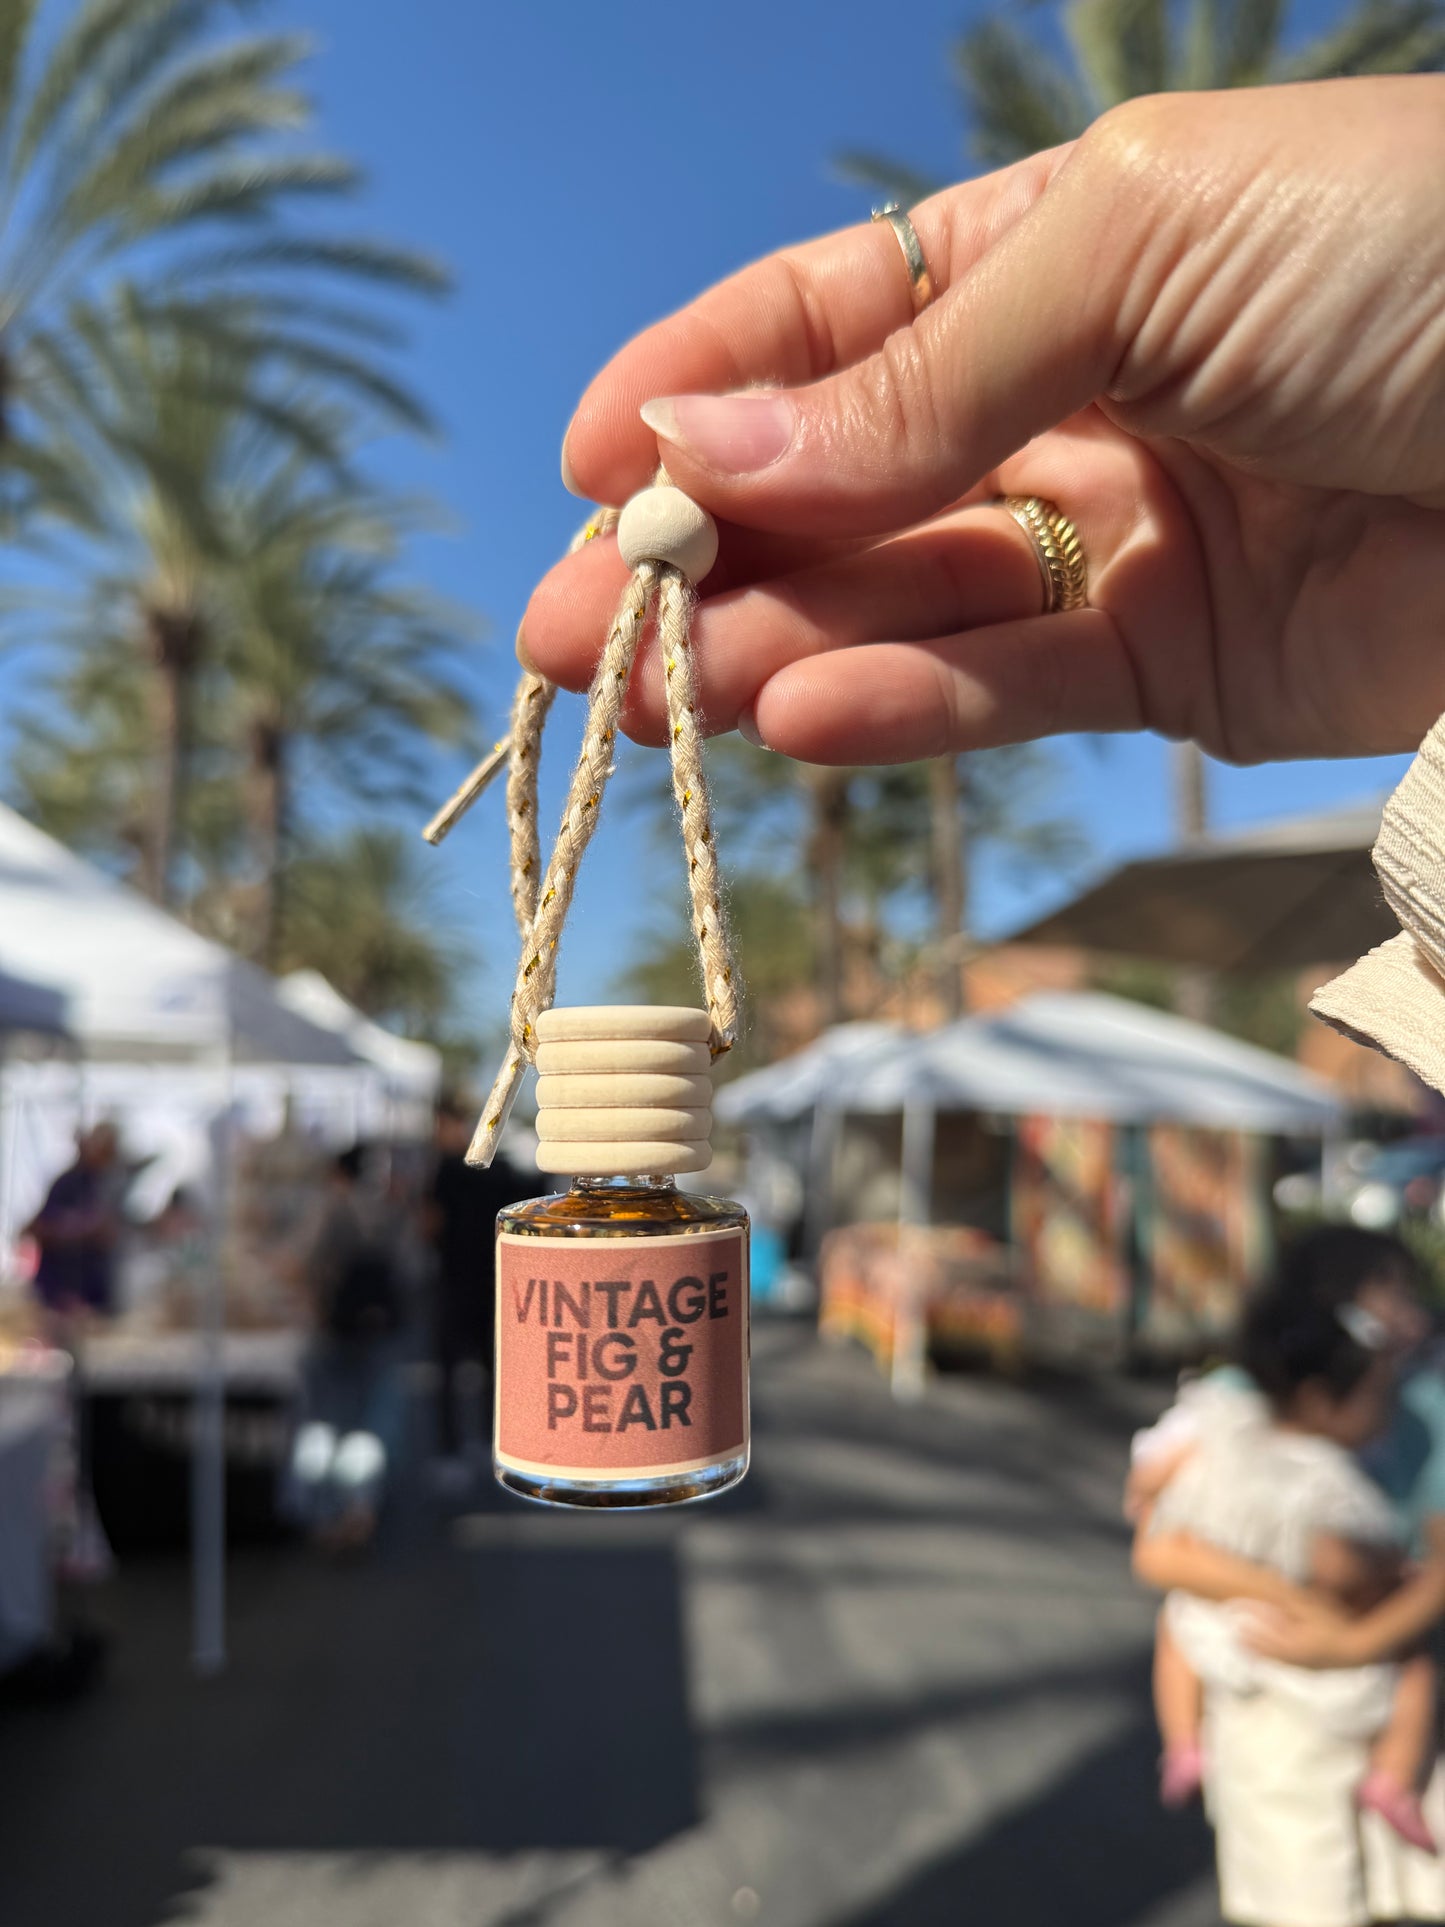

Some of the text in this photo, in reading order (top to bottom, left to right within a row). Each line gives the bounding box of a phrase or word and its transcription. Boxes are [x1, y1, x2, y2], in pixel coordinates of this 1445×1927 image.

[513, 1272, 728, 1328] VINTAGE
[546, 1327, 693, 1380] FIG &
[547, 1380, 692, 1432] PEAR
